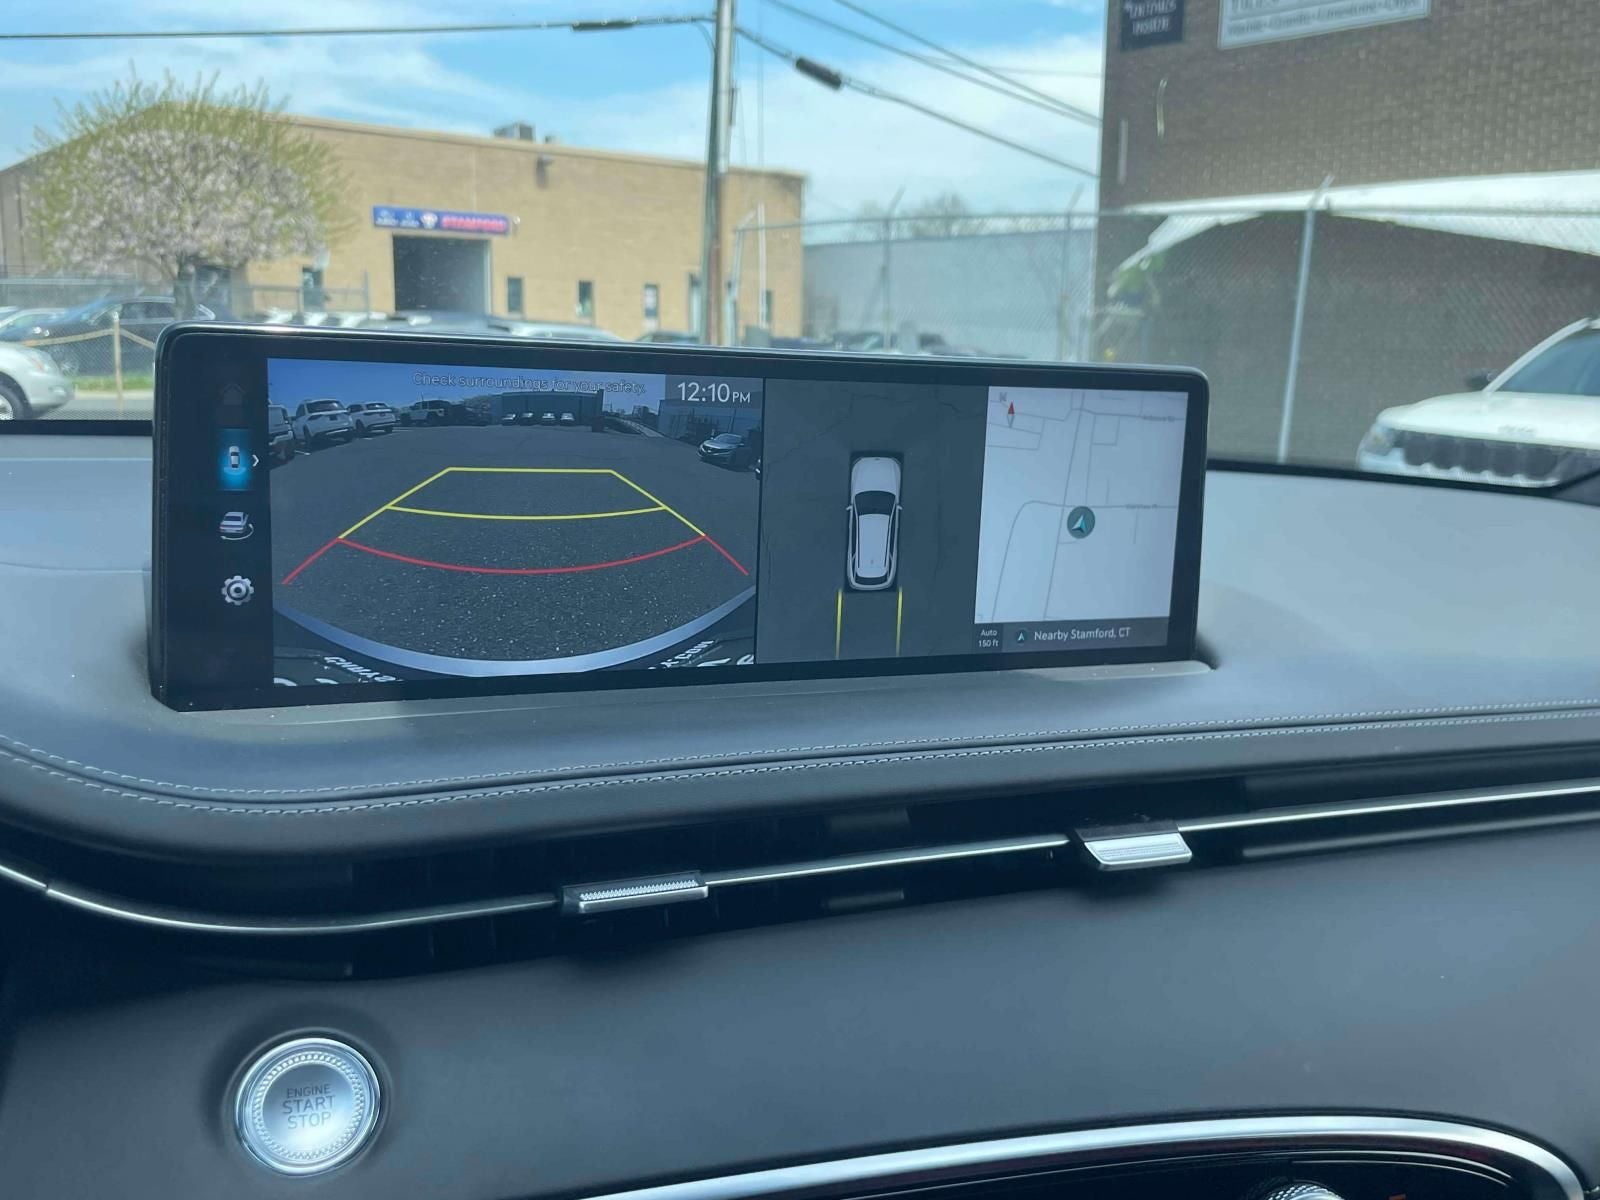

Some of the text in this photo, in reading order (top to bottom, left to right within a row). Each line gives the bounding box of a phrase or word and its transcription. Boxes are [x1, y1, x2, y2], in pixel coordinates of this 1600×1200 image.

[412, 372, 646, 396] Check surroundings for your safety.
[677, 382, 751, 404] 12:10 PM
[980, 629, 998, 637] Auto
[1034, 627, 1131, 642] Nearby Stamford, CT
[978, 639, 999, 648] 150 ft
[286, 1083, 331, 1098] ENGINE
[282, 1095, 336, 1115] START
[288, 1111, 332, 1129] STOP
